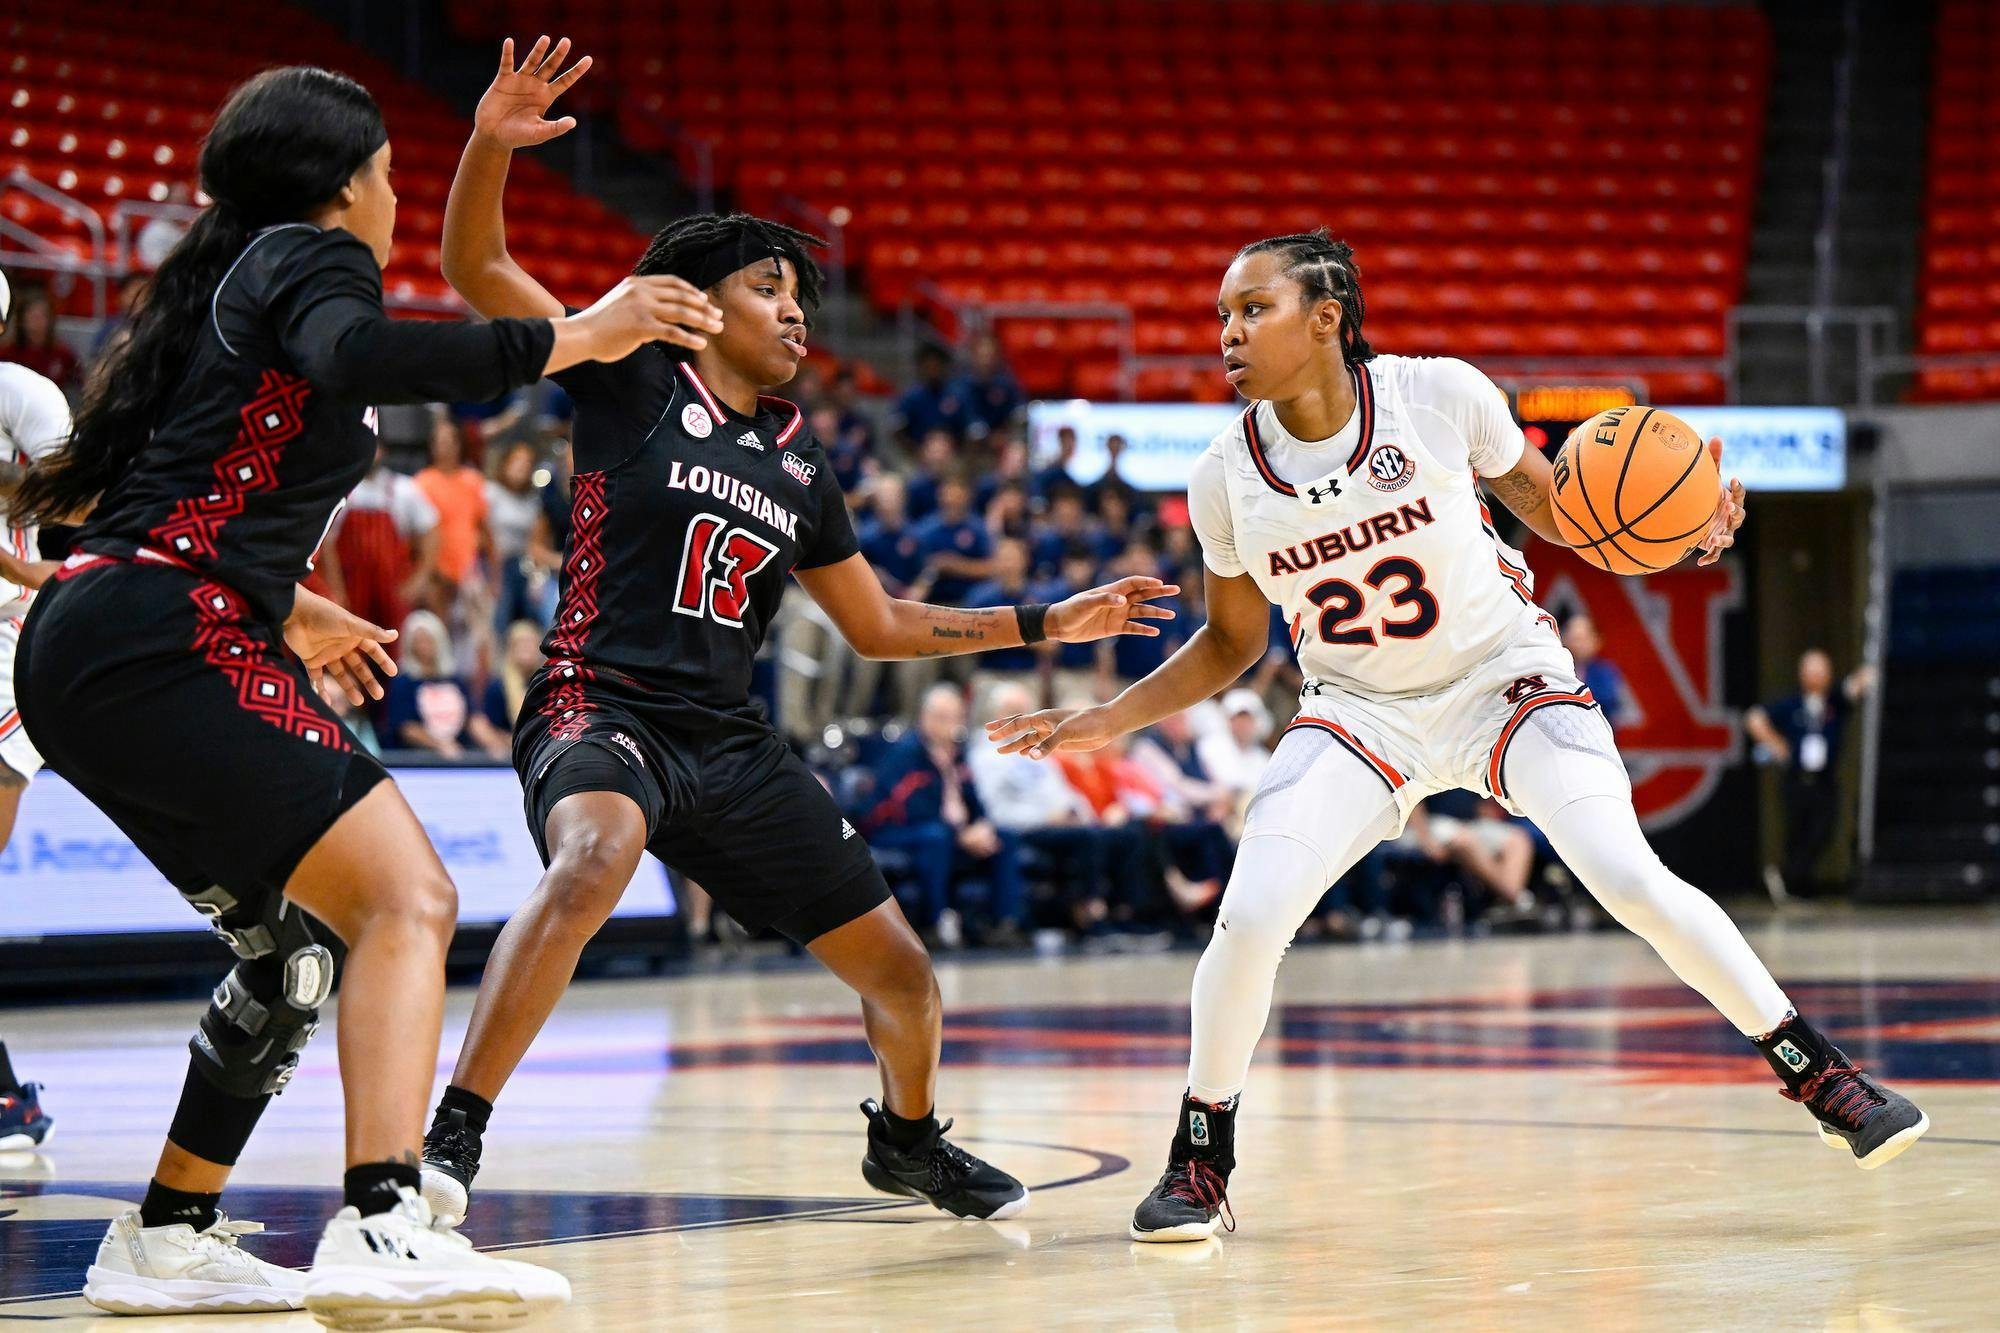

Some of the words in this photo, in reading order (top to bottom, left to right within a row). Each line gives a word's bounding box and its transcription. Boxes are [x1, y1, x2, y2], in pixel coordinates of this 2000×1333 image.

[736, 438, 765, 452] adidas
[1371, 447, 1405, 480] SEC
[1375, 470, 1413, 490] GRADUATE
[667, 461, 798, 542] LOUISIANA
[1267, 496, 1436, 577] AUBURN
[671, 512, 781, 629] 13
[1305, 555, 1440, 648] 23
